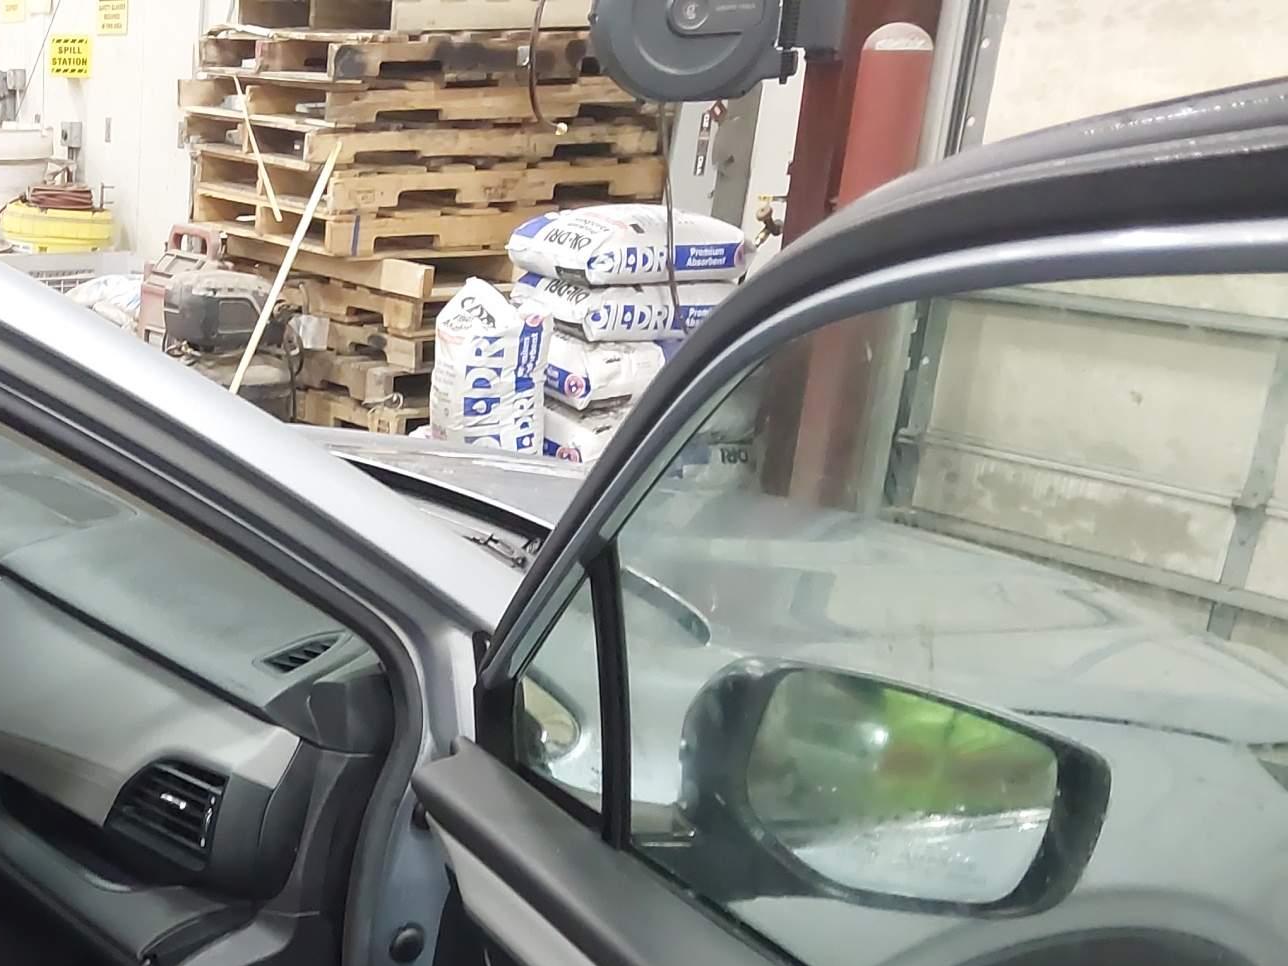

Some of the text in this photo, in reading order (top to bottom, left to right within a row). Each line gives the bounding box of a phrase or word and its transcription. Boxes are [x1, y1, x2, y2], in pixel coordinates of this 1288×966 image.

[57, 46, 83, 55] SPILL
[51, 57, 88, 66] STATION
[689, 246, 725, 256] Premium
[686, 255, 727, 267] Absorbent
